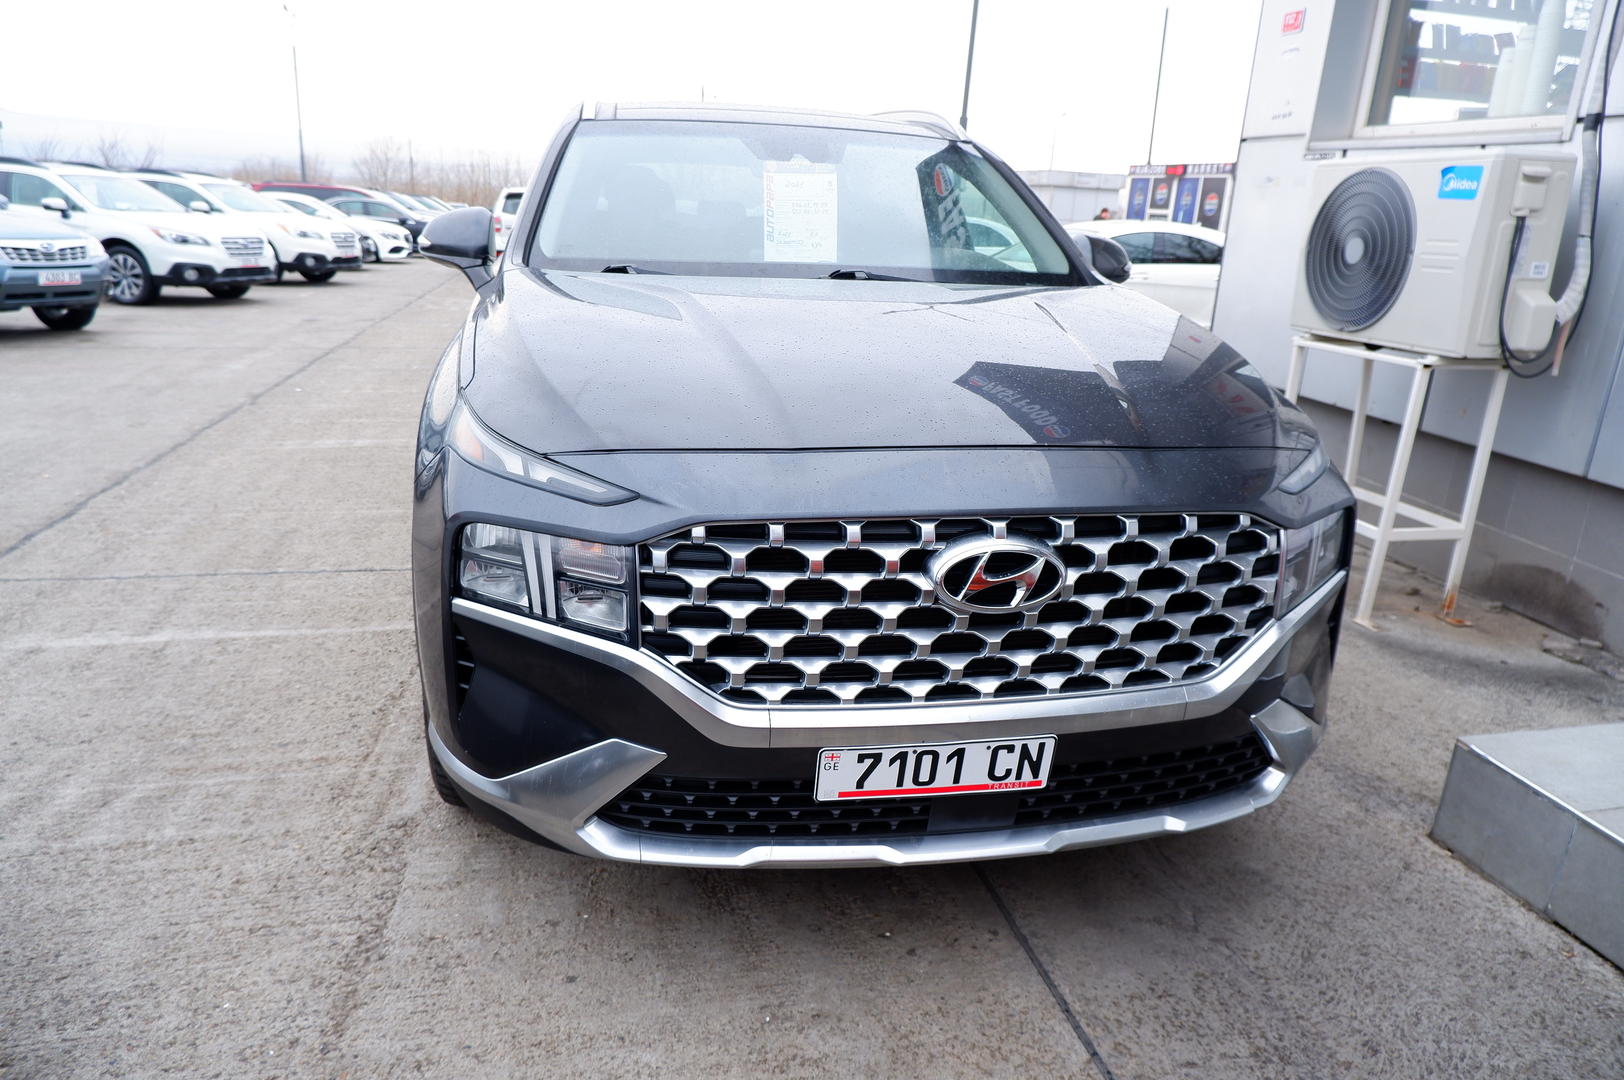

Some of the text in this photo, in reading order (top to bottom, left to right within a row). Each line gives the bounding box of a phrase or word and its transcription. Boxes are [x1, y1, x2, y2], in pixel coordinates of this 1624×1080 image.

[1442, 173, 1478, 191] Midea
[823, 761, 840, 772] GE
[855, 741, 1046, 790] 7101 CN
[987, 780, 1031, 790] TRANSIT
